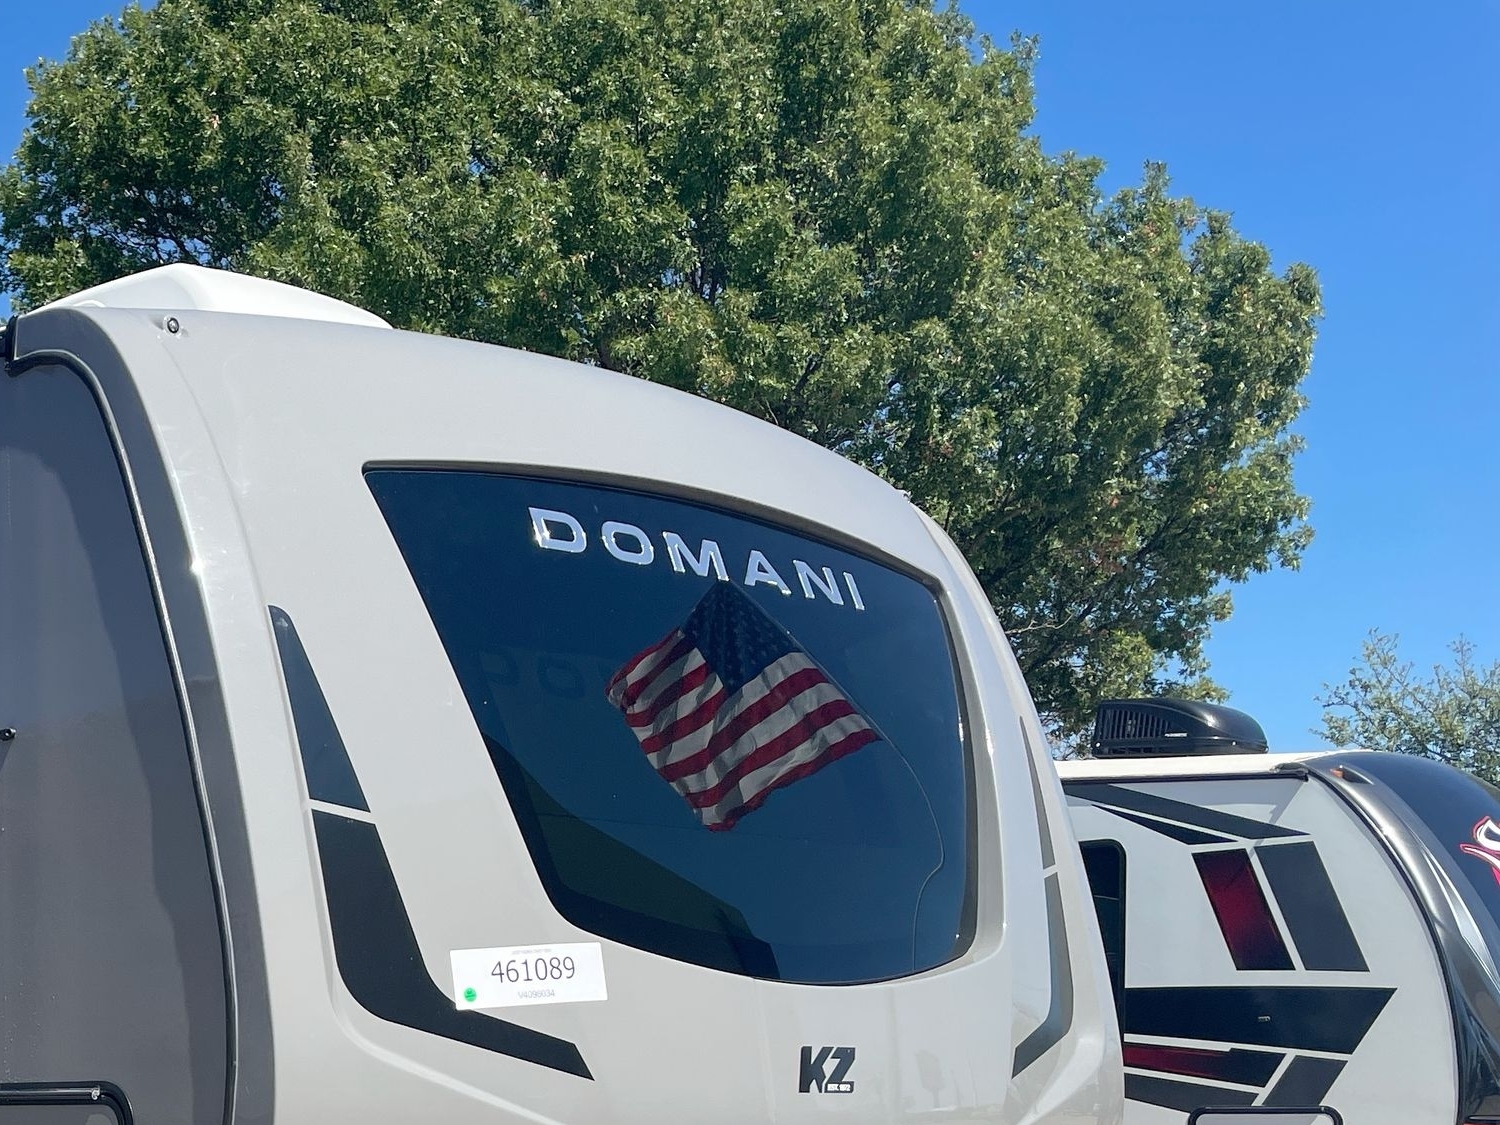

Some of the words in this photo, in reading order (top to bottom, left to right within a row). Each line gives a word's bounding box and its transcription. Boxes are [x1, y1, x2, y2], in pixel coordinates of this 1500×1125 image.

[528, 507, 865, 611] DOMANI
[491, 956, 575, 983] 461089
[799, 1046, 856, 1093] KZ
